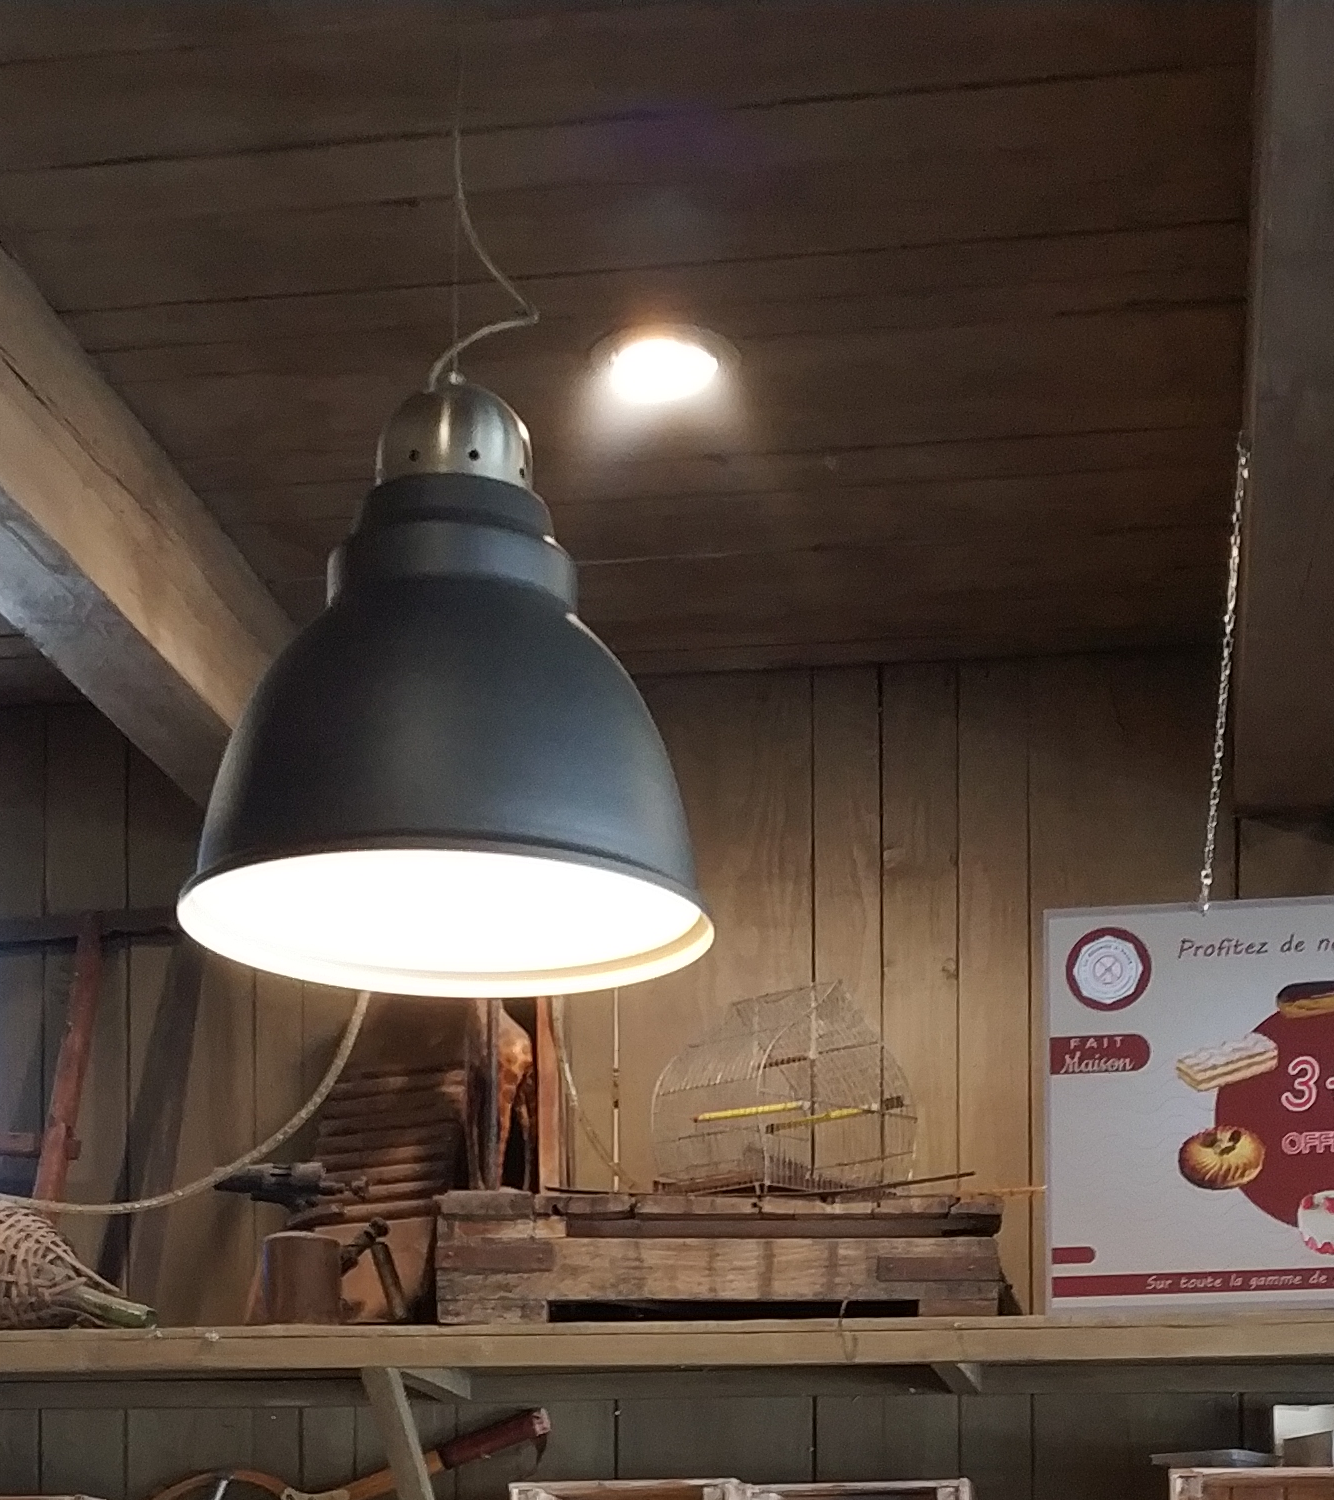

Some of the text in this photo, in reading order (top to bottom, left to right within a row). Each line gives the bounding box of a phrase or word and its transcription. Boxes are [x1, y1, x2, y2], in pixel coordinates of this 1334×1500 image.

[1177, 937, 1269, 959] Profitez
[1280, 933, 1306, 953] de
[1069, 1036, 1124, 1050] FAIT
[1060, 1051, 1135, 1075] Maison
[1146, 1275, 1173, 1290] Sur
[1179, 1276, 1222, 1289] toute
[1229, 1273, 1243, 1287] la
[1249, 1275, 1303, 1290] gamme
[1308, 1270, 1327, 1285] de
